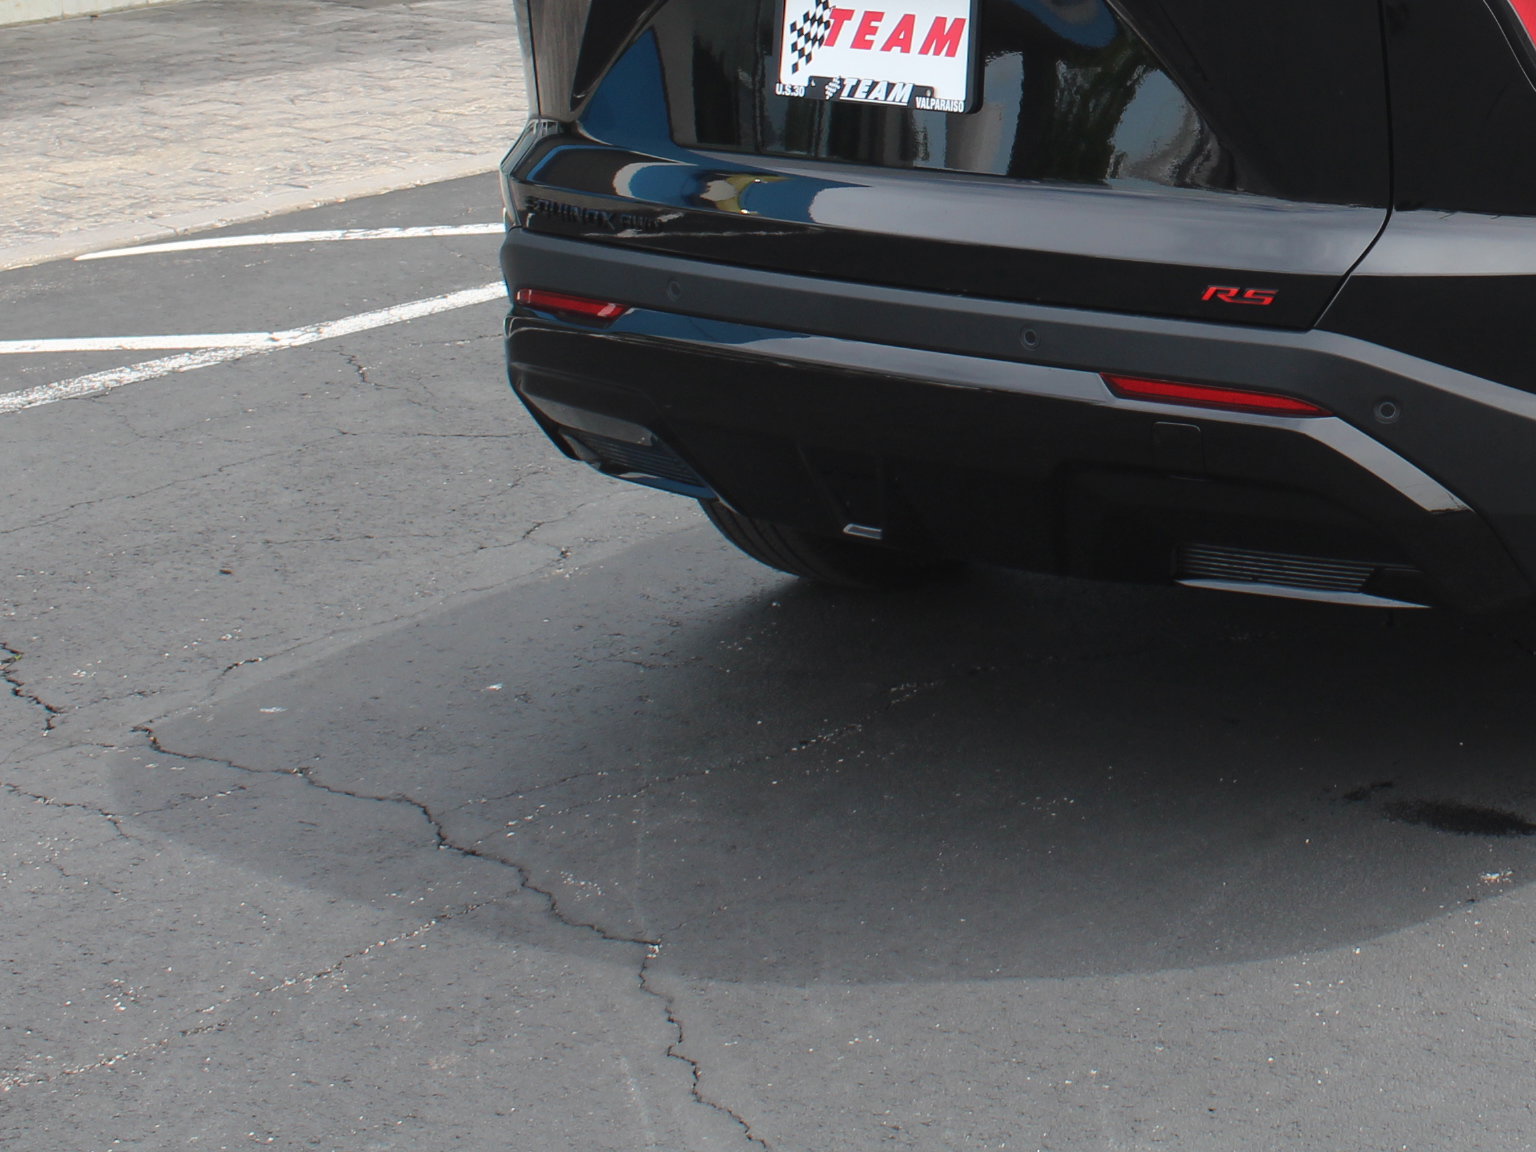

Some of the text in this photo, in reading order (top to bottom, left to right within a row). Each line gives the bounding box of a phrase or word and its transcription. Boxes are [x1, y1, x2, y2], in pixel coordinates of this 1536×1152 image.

[823, 8, 966, 58] TEAM
[840, 77, 914, 104] TEAM
[915, 96, 965, 113] VALPARAISO
[1201, 285, 1278, 306] RS
